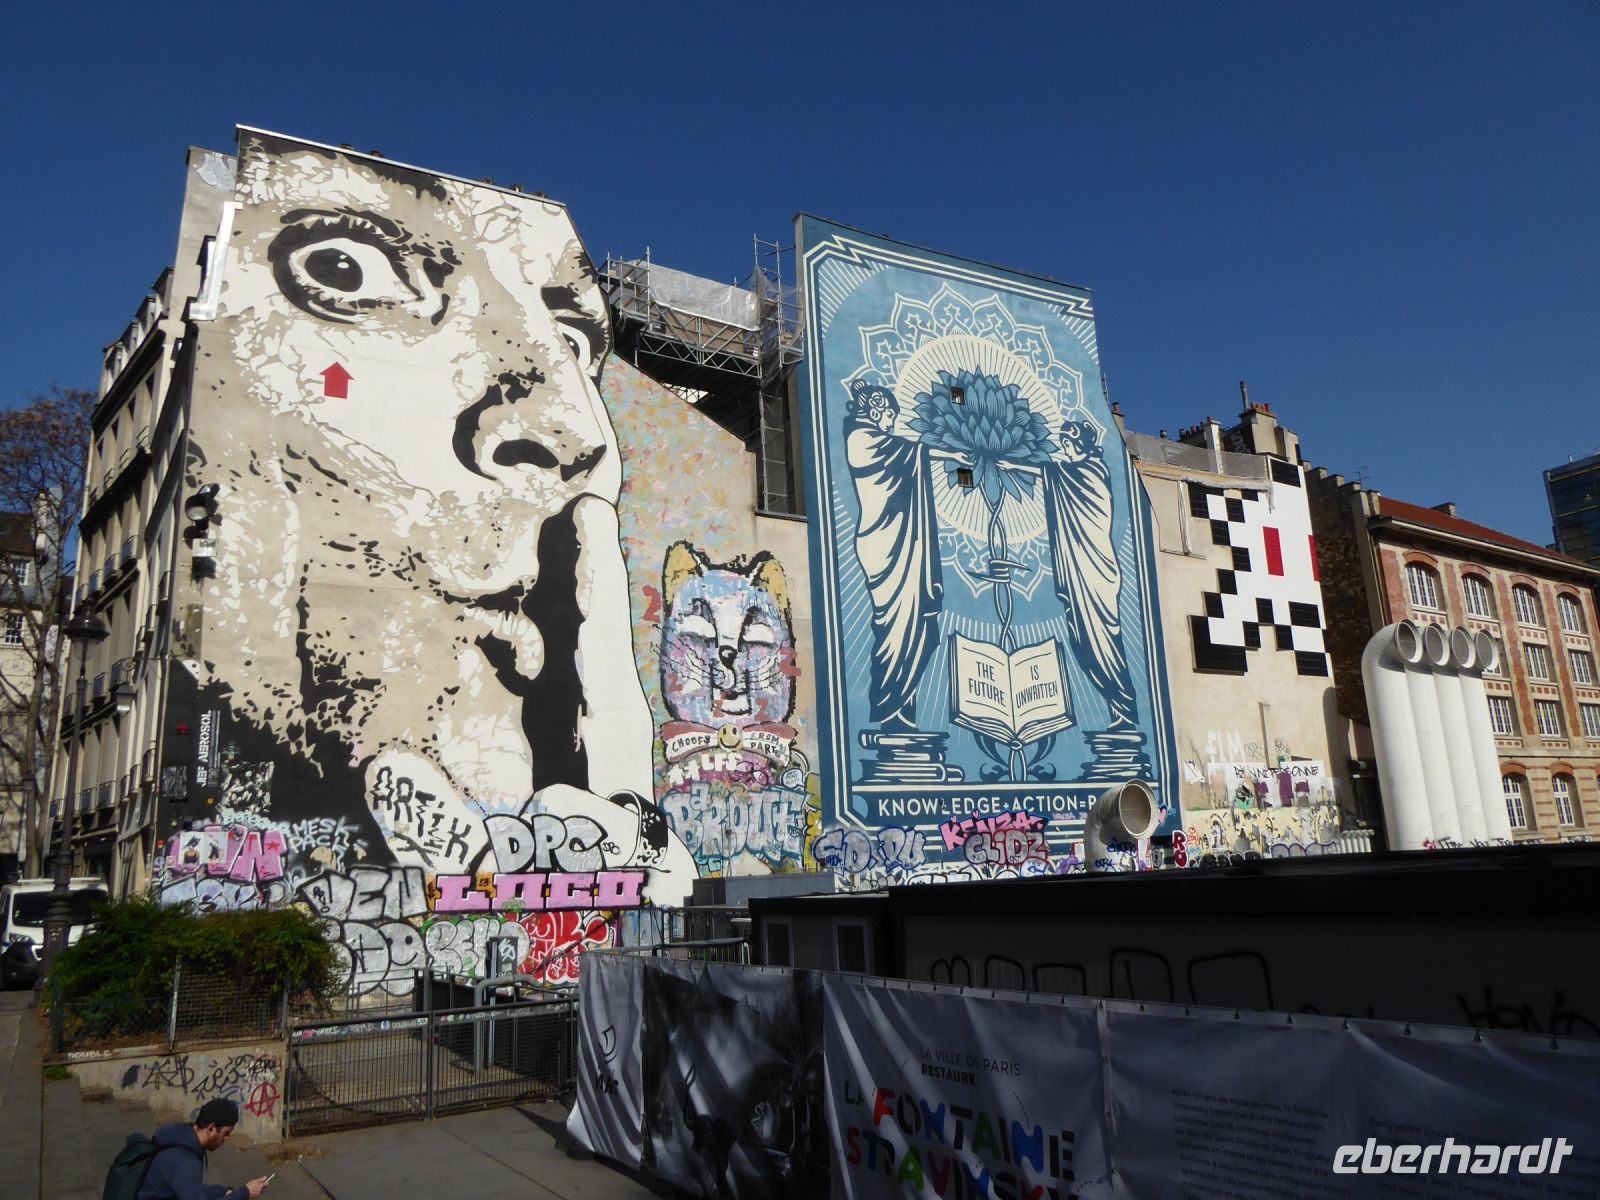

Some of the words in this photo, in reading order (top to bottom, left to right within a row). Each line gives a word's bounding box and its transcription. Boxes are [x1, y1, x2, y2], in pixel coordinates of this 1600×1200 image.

[976, 661, 996, 682] THE
[1030, 664, 1040, 681] IS
[968, 678, 1006, 707] FUTURE
[1015, 680, 1058, 709] UNWRITTEN
[434, 869, 650, 913] LOCO
[921, 1047, 933, 1059] LA
[935, 1050, 964, 1066] VILLE
[966, 1055, 981, 1069] DE
[983, 1058, 1022, 1077] PARIS
[921, 1063, 976, 1086] RESTAURE
[873, 1087, 1075, 1183] FONTAINE
[847, 1126, 1079, 1200] STRAVINSK
